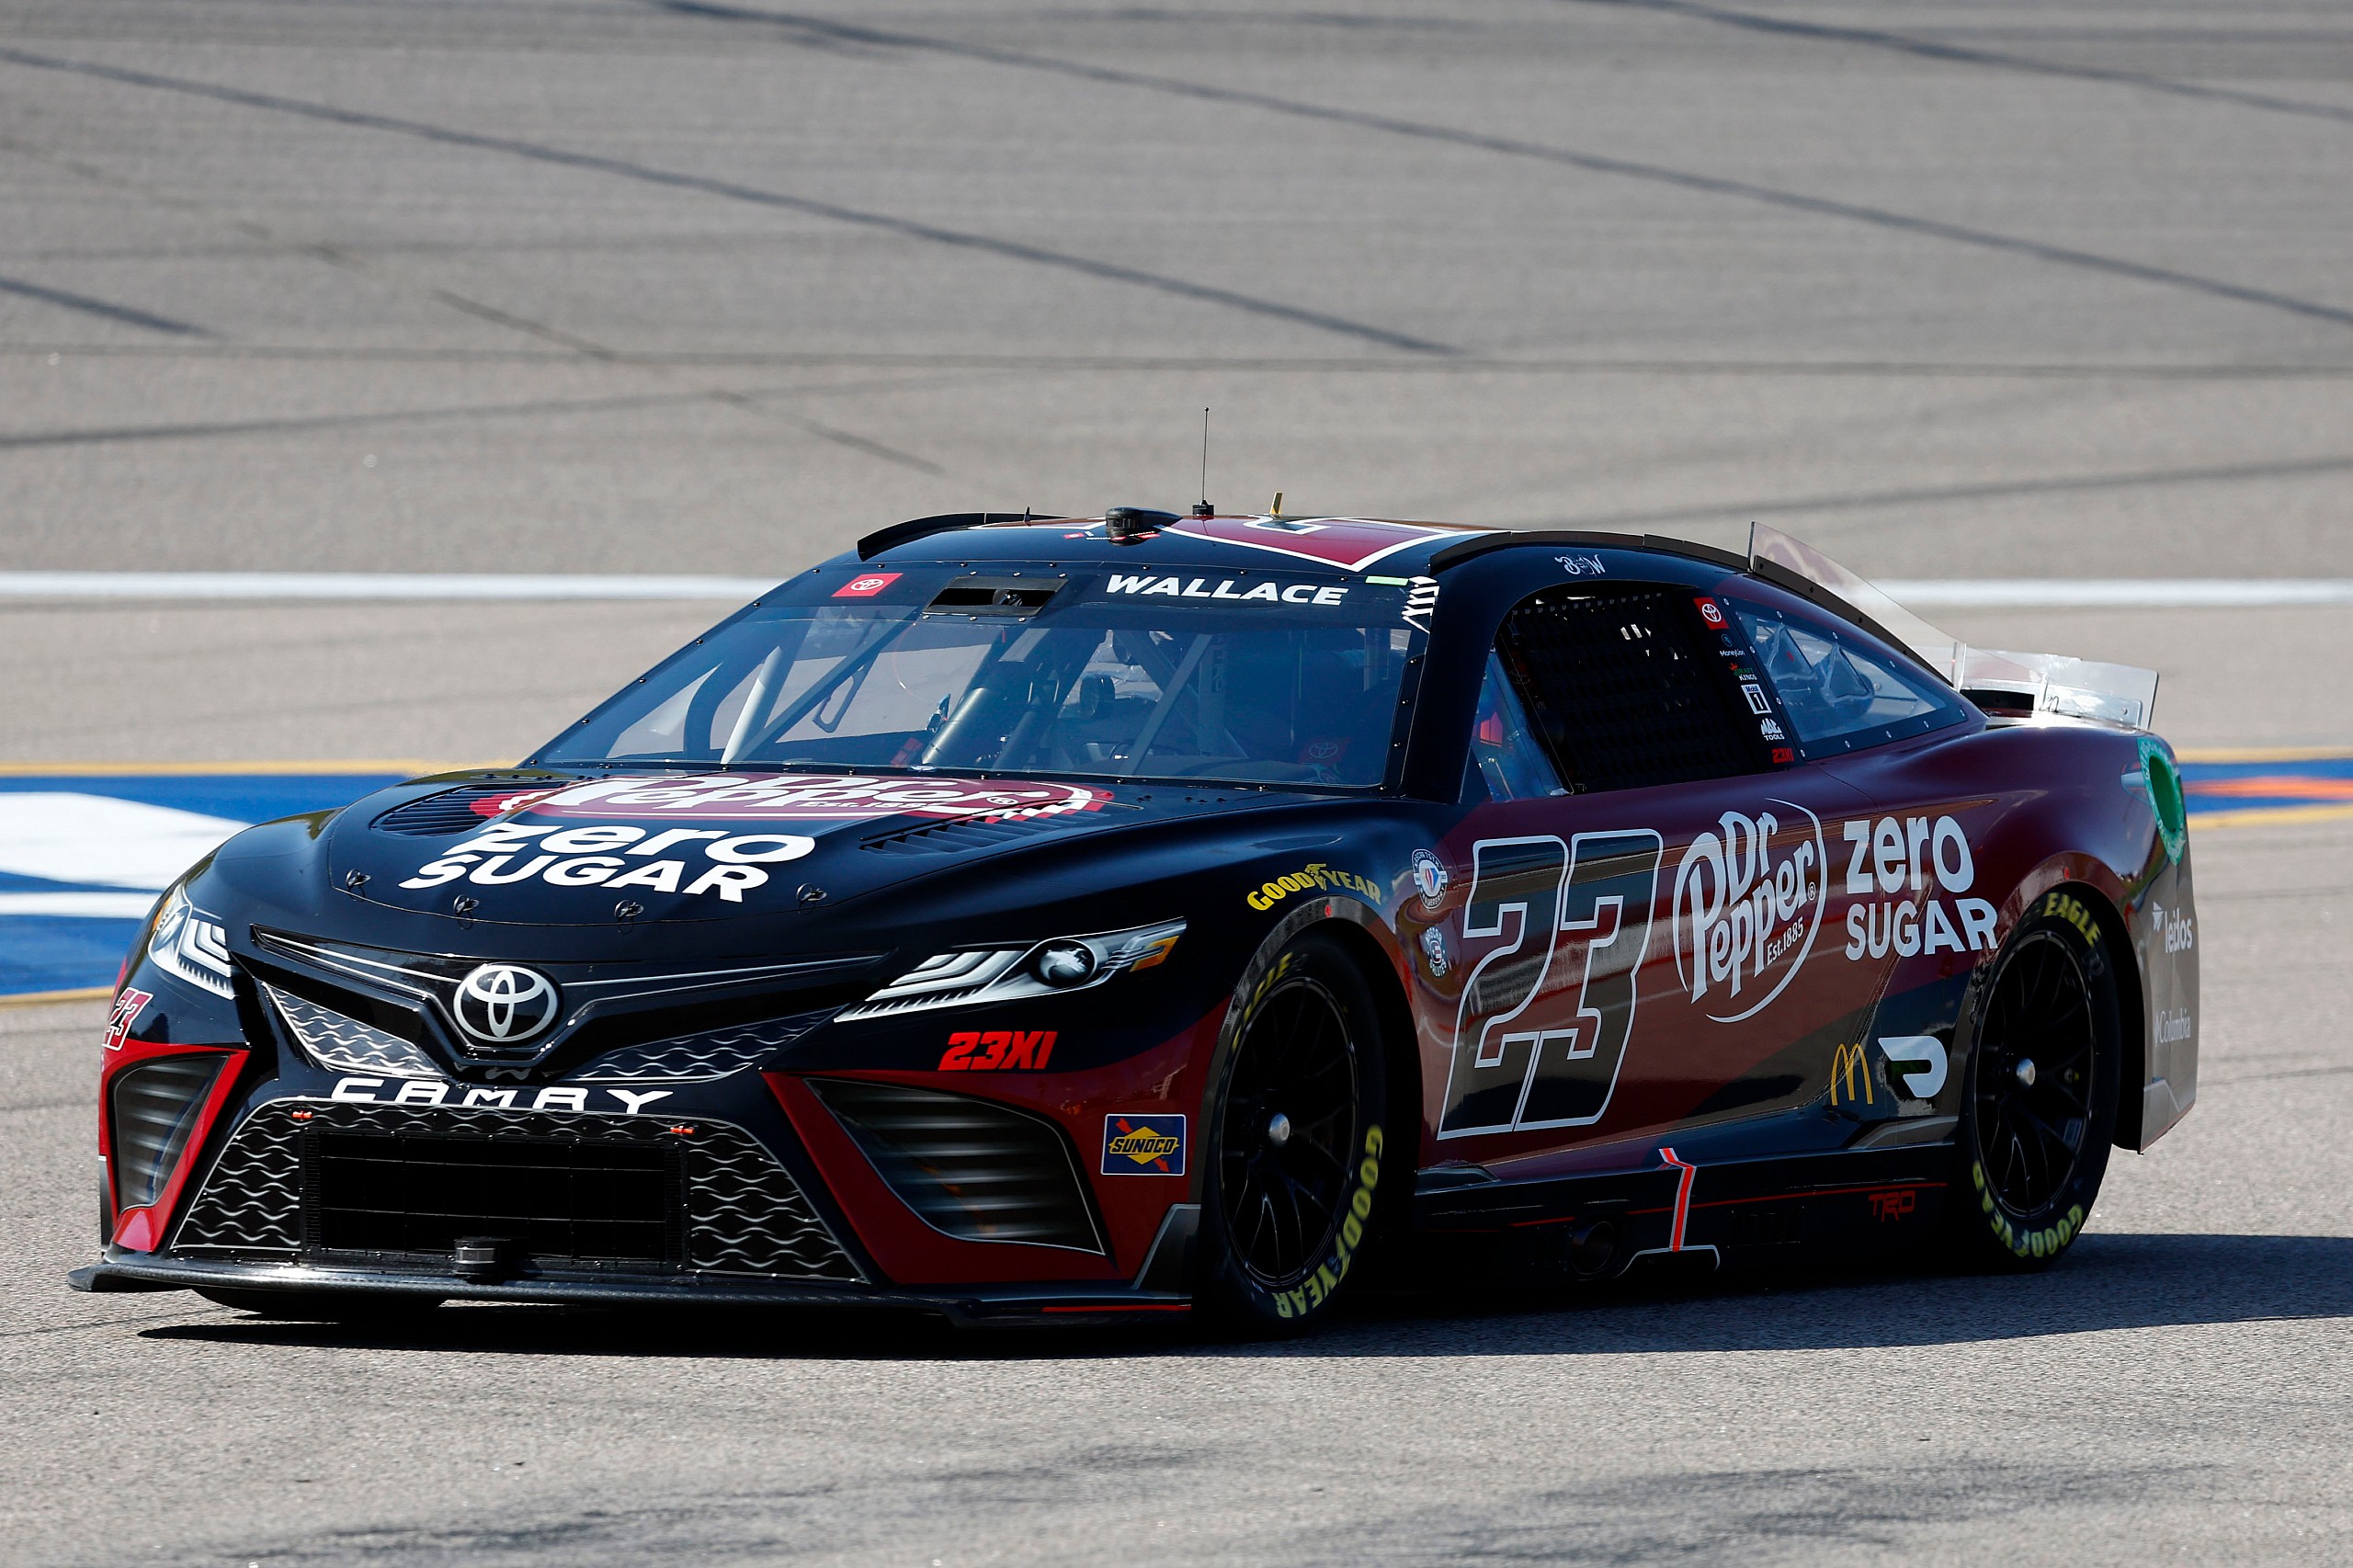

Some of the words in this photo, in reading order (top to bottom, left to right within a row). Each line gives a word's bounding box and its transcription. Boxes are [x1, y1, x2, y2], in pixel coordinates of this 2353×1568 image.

[1106, 574, 1349, 606] WALLACE
[1760, 718, 1782, 735] MAC
[1771, 747, 1794, 764] 23XI
[442, 823, 816, 864] zero
[1718, 811, 1779, 904] Dr
[1844, 815, 1974, 894] zero
[398, 854, 769, 903] SUGAR
[1246, 863, 1381, 911] GOODYEAR
[1673, 832, 1814, 1005] Pepper
[1845, 897, 1999, 961] SUGAR
[2043, 892, 2101, 949] EAGLE
[2165, 907, 2193, 954] leidos
[1437, 828, 1664, 1141] 23
[101, 986, 154, 1051] 23
[2159, 1006, 2191, 1044] Columbia
[938, 1030, 1058, 1071] 23XI
[1109, 1137, 1178, 1154] SUNOCO
[1869, 1190, 1915, 1222] TRD
